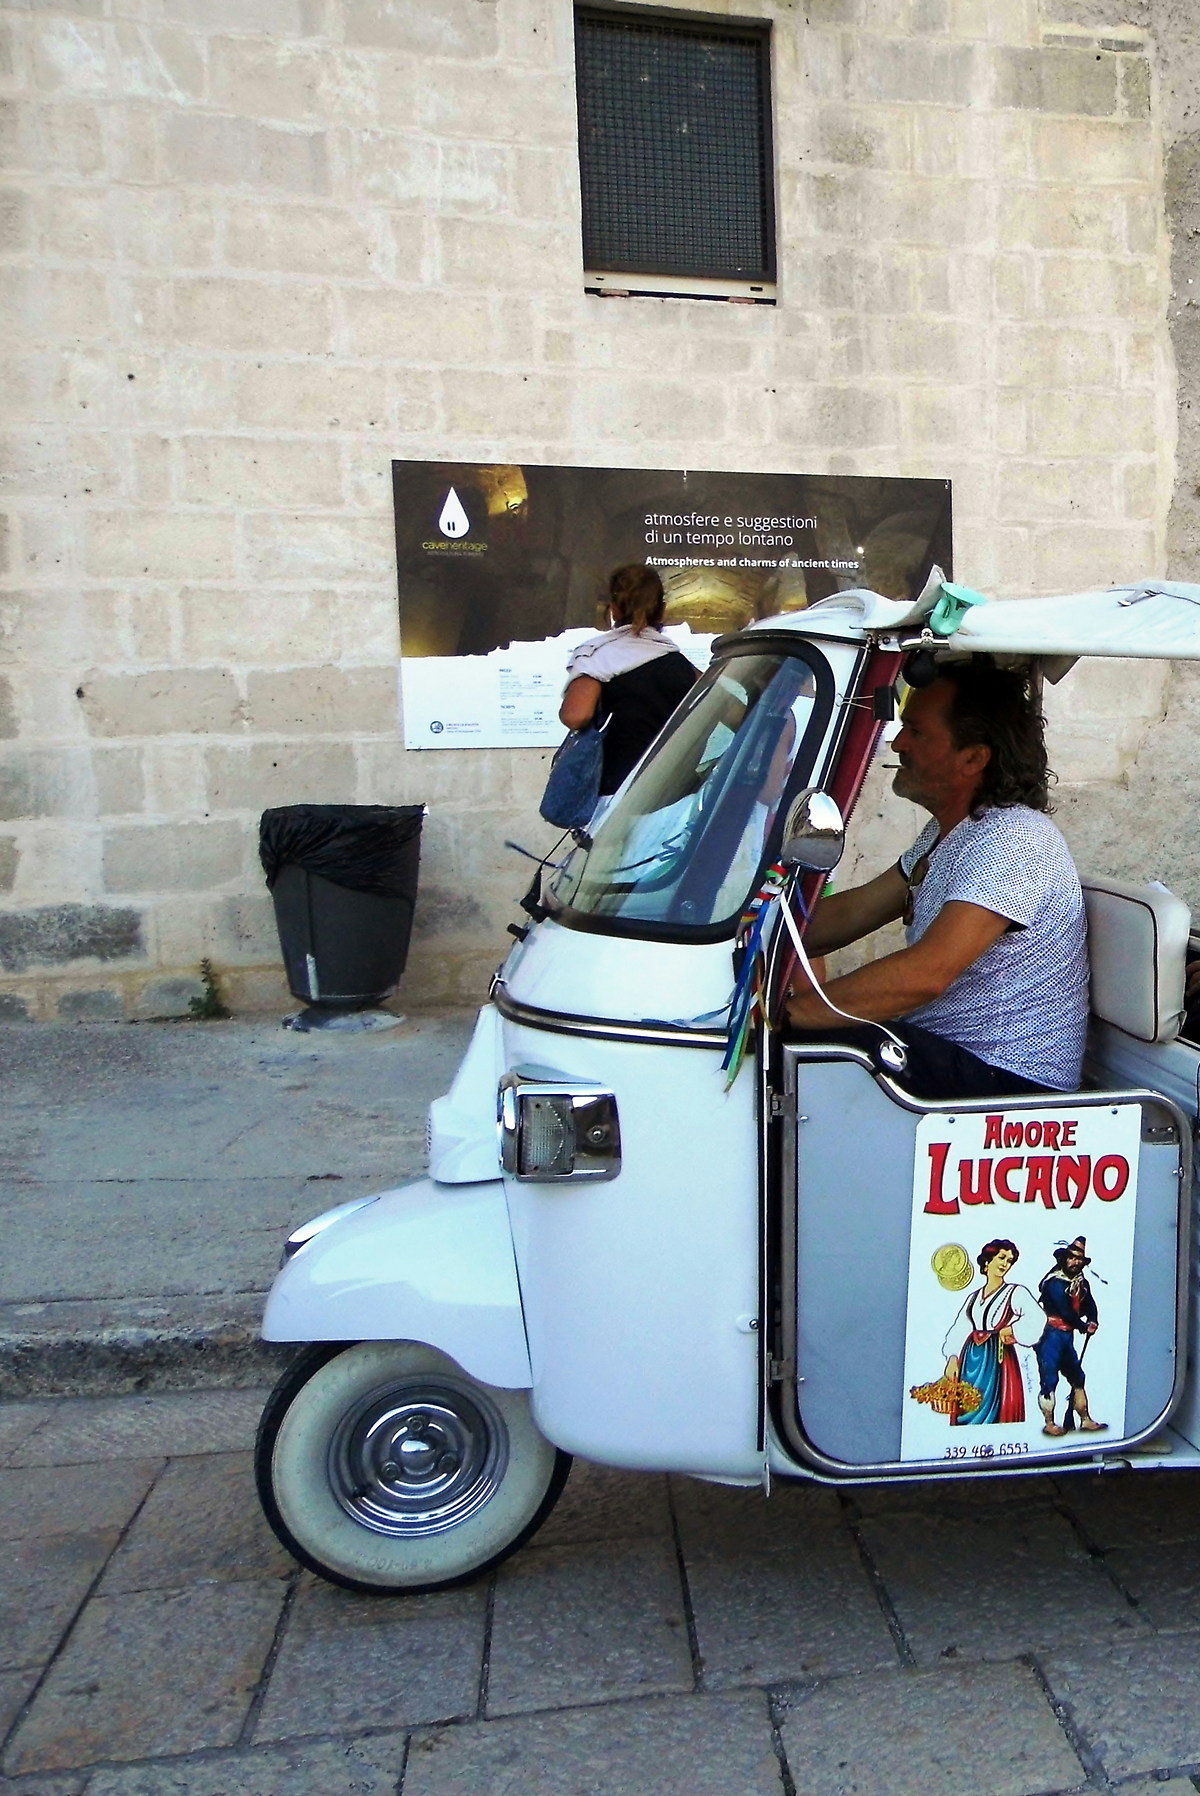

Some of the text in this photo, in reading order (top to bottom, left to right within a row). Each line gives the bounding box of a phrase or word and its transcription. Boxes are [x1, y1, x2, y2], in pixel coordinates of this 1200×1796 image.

[644, 512, 818, 532] atmosfere e suggestioni
[645, 530, 794, 548] di un tempo lontano
[645, 556, 859, 569] Atmospheres and charms of ancient times
[984, 1115, 1079, 1151] AMORE
[923, 1142, 1130, 1215] LUCANO
[944, 1446, 967, 1459] 339
[999, 1442, 1029, 1456] 6553
